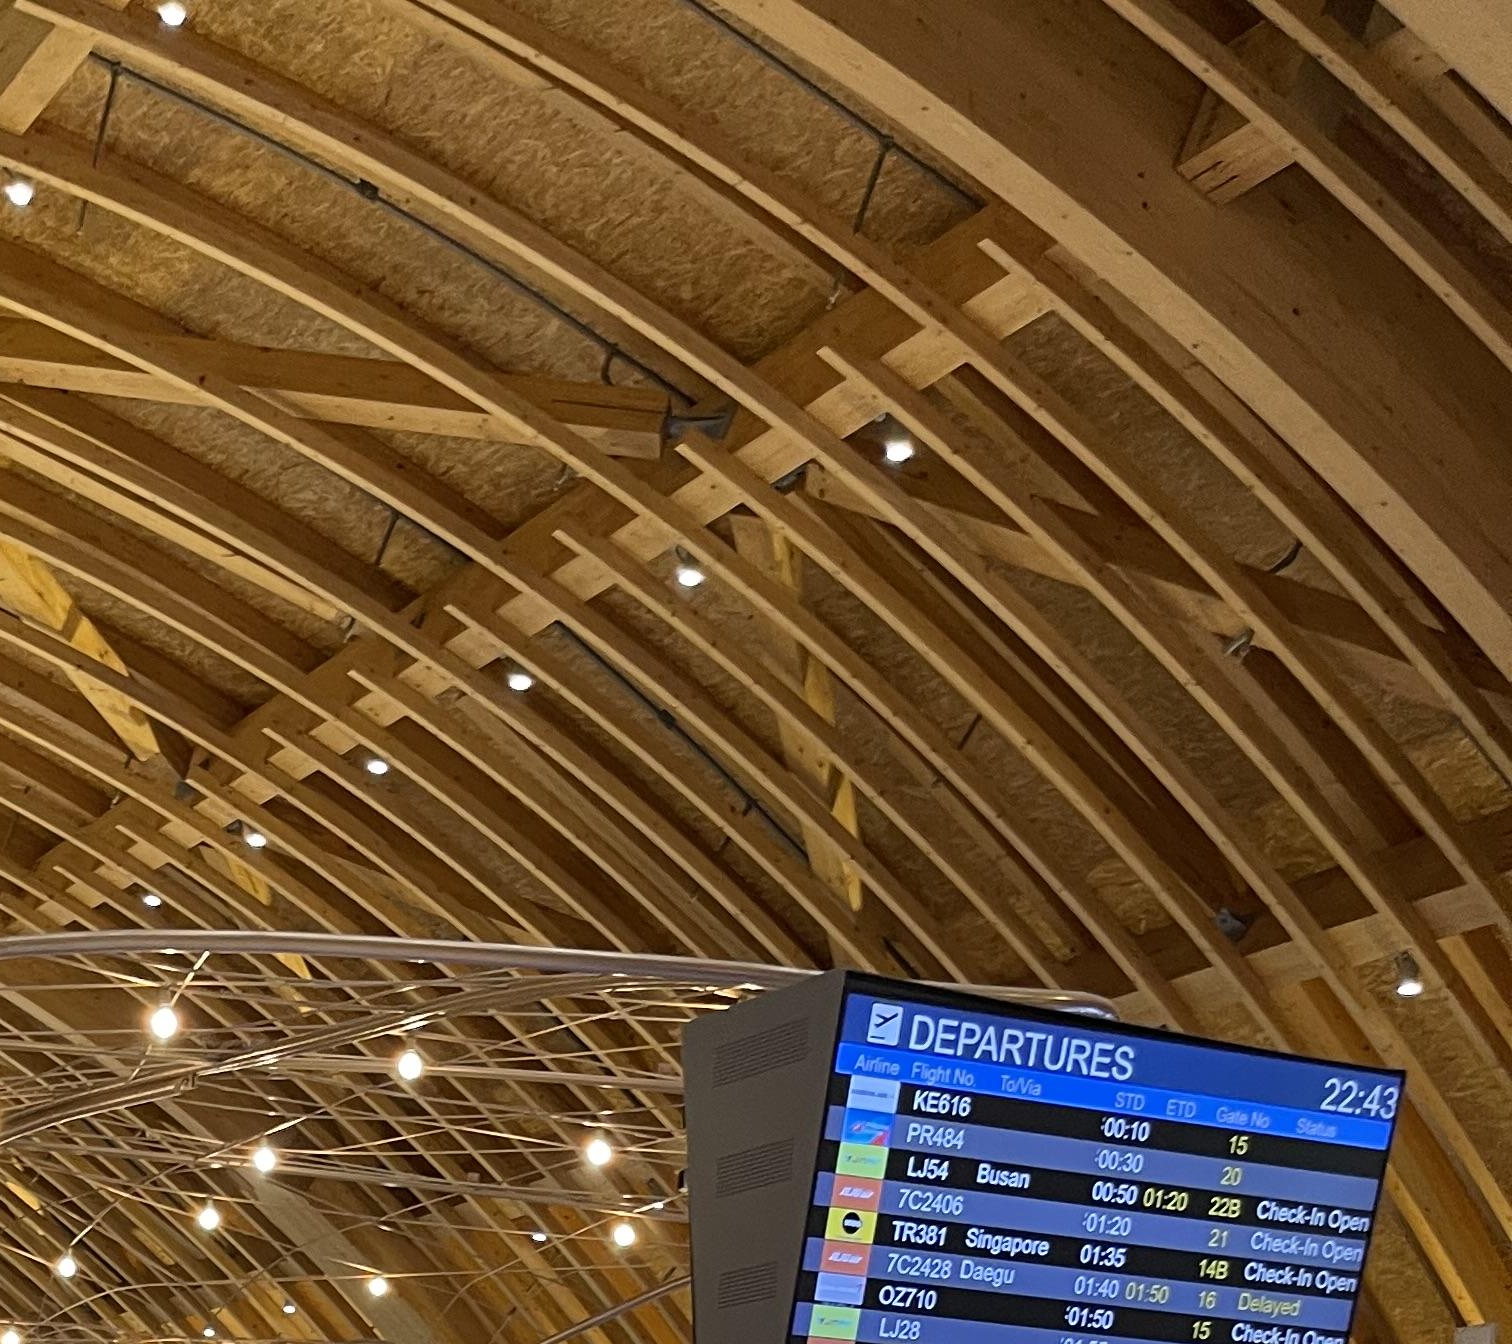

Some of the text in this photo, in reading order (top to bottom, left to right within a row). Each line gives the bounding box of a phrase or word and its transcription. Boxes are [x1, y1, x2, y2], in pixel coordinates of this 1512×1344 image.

[908, 1014, 1135, 1081] DEPARTURES
[854, 1054, 900, 1076] Airline
[911, 1062, 951, 1086] Flight
[952, 1068, 976, 1086] No.
[1000, 1074, 1042, 1096] To/Via
[1114, 1091, 1146, 1111] STD
[1166, 1099, 1197, 1118] ETD
[1215, 1106, 1248, 1127] Gate
[1295, 1118, 1337, 1138] Status
[913, 1090, 971, 1117] KE616
[1228, 1135, 1249, 1155] 15
[1320, 1078, 1399, 1119] 22:43
[906, 1123, 965, 1149] PR484
[1220, 1166, 1242, 1187] 20
[898, 1189, 964, 1216] 7C2406
[1208, 1228, 1229, 1249] 21
[1250, 1231, 1319, 1259] Check-In
[1321, 1240, 1364, 1264] Open
[907, 1156, 949, 1181] LJ54
[976, 1163, 1030, 1189] Busan
[1092, 1181, 1138, 1205] 00:50
[1142, 1187, 1189, 1212] 01:20
[1208, 1196, 1241, 1218] 22B
[1256, 1200, 1325, 1228] Check-In
[1328, 1209, 1370, 1234] Open
[887, 1253, 952, 1279] 7C2428
[959, 1259, 1016, 1287] Daegu
[1073, 1275, 1120, 1299] 01:40
[1125, 1280, 1170, 1305] 01:50
[1198, 1290, 1218, 1310] 16
[1237, 1292, 1302, 1319] Delayed
[892, 1220, 947, 1246] TR381
[965, 1227, 1050, 1257] Singapore
[1080, 1244, 1127, 1268] 01:35
[1198, 1258, 1230, 1279] 14B
[1244, 1262, 1312, 1288] Check-In
[1314, 1270, 1357, 1294] Open
[878, 1285, 937, 1310] OZ710
[1192, 1320, 1211, 1340] 15
[879, 1317, 921, 1340] LJ28
